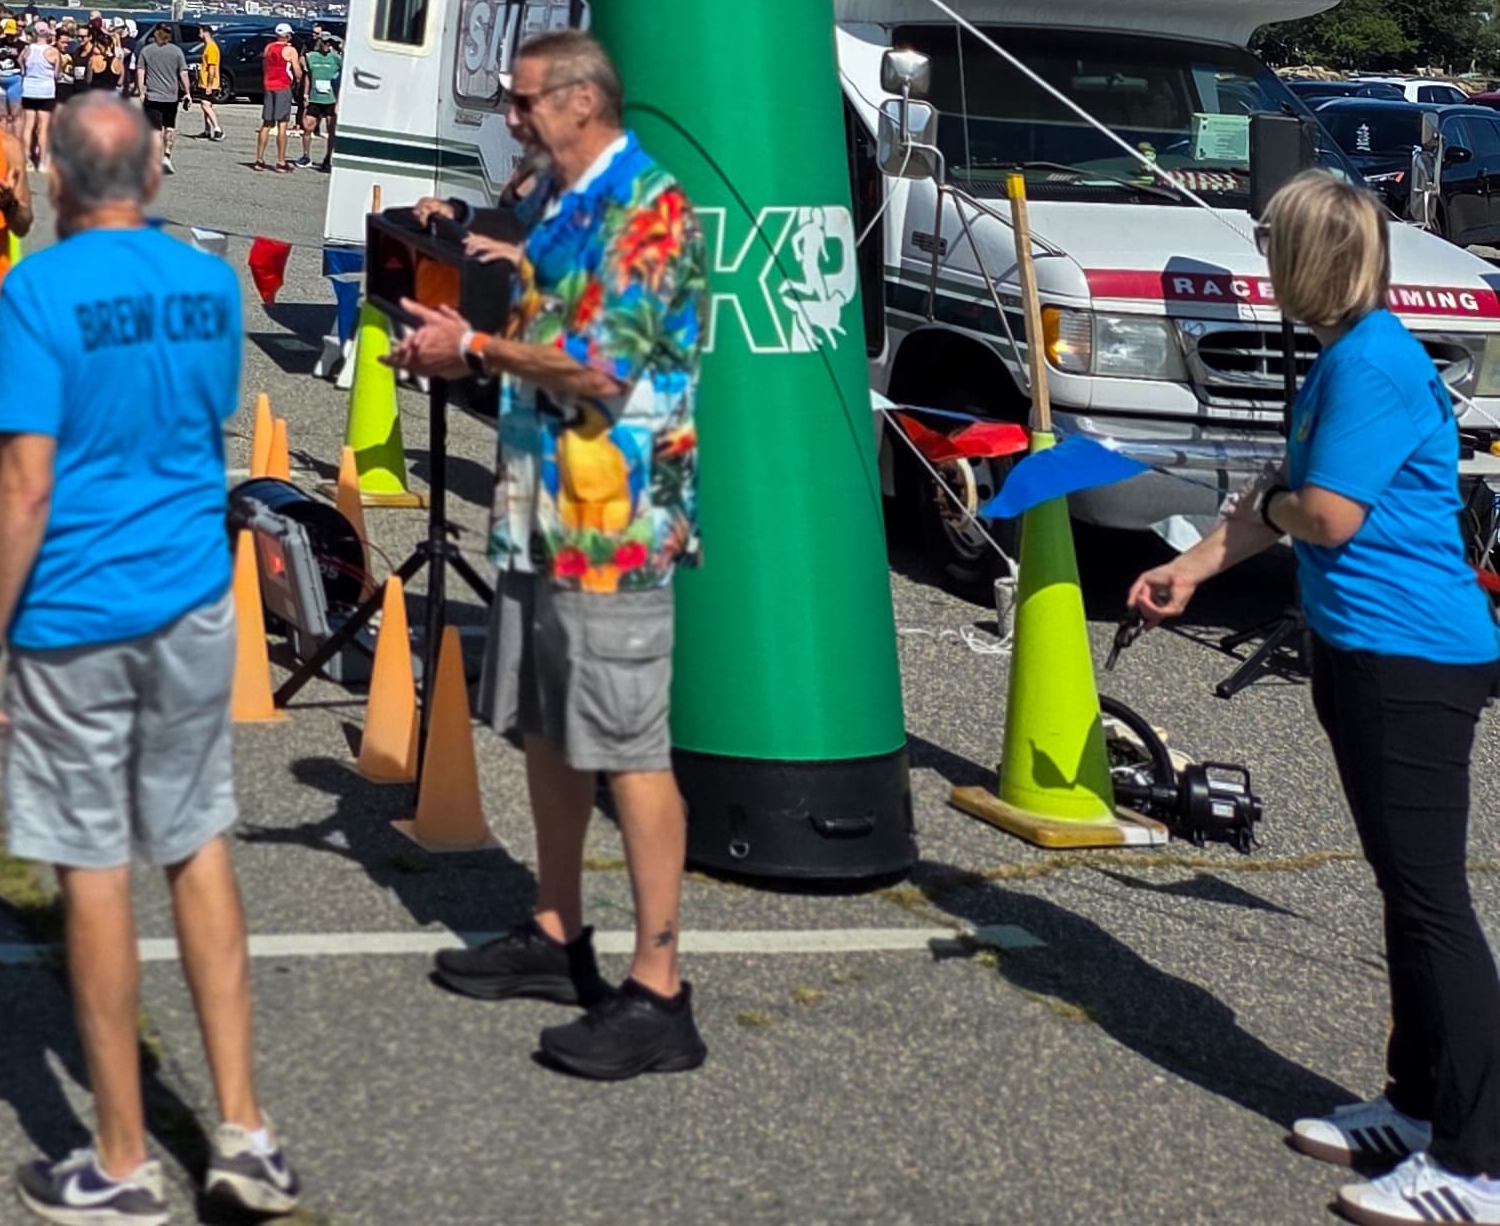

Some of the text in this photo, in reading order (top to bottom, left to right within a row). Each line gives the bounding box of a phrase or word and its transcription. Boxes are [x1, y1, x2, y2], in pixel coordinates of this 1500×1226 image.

[1172, 276, 1480, 311] RACE IMING
[73, 291, 233, 353] BREW CREW
